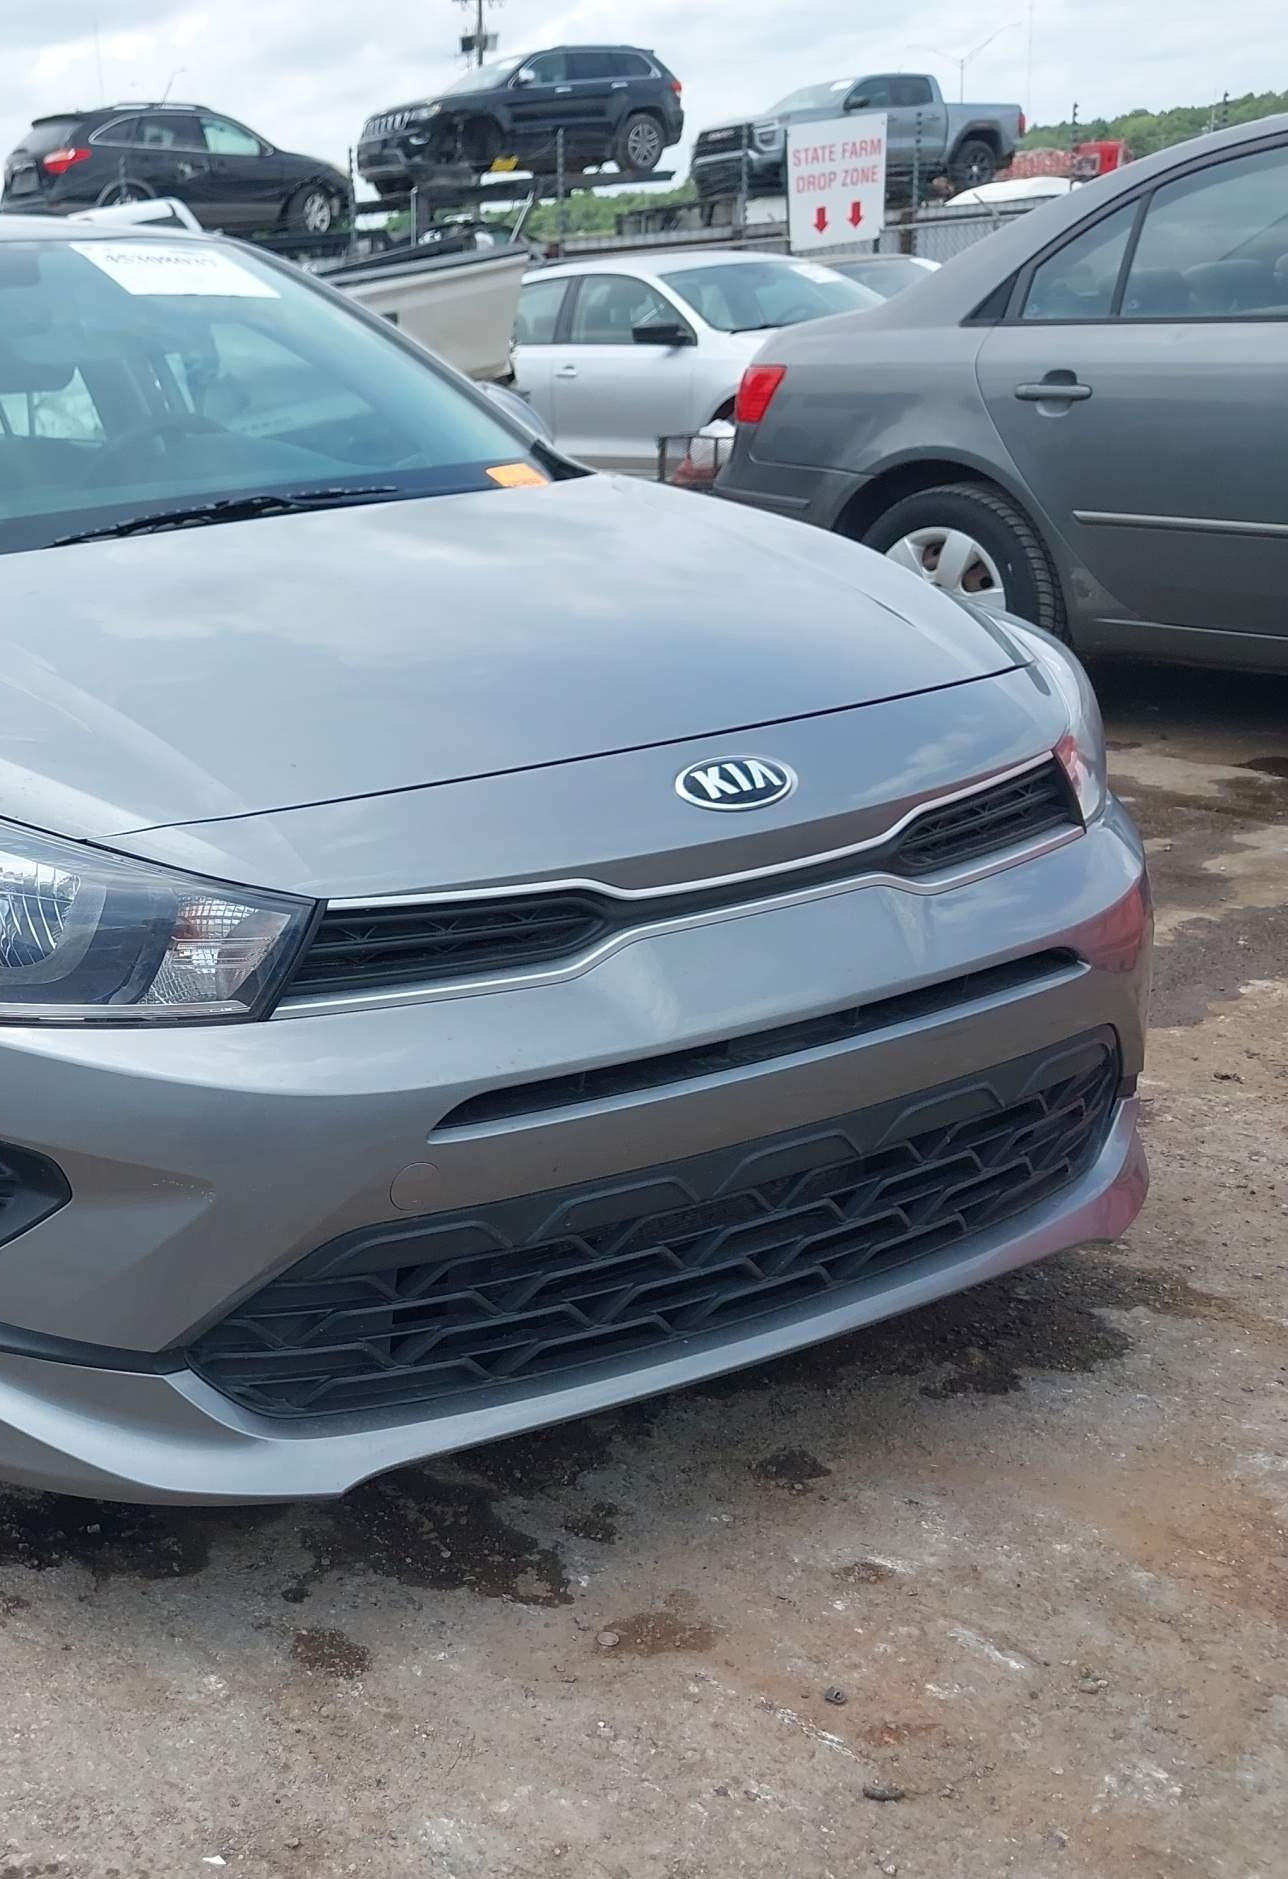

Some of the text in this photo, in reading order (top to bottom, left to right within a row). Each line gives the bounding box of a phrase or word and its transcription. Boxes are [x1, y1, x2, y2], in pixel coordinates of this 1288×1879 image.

[792, 138, 882, 167] STATE FARM
[795, 165, 879, 194] DROP ZONE
[689, 759, 783, 800] KIA
